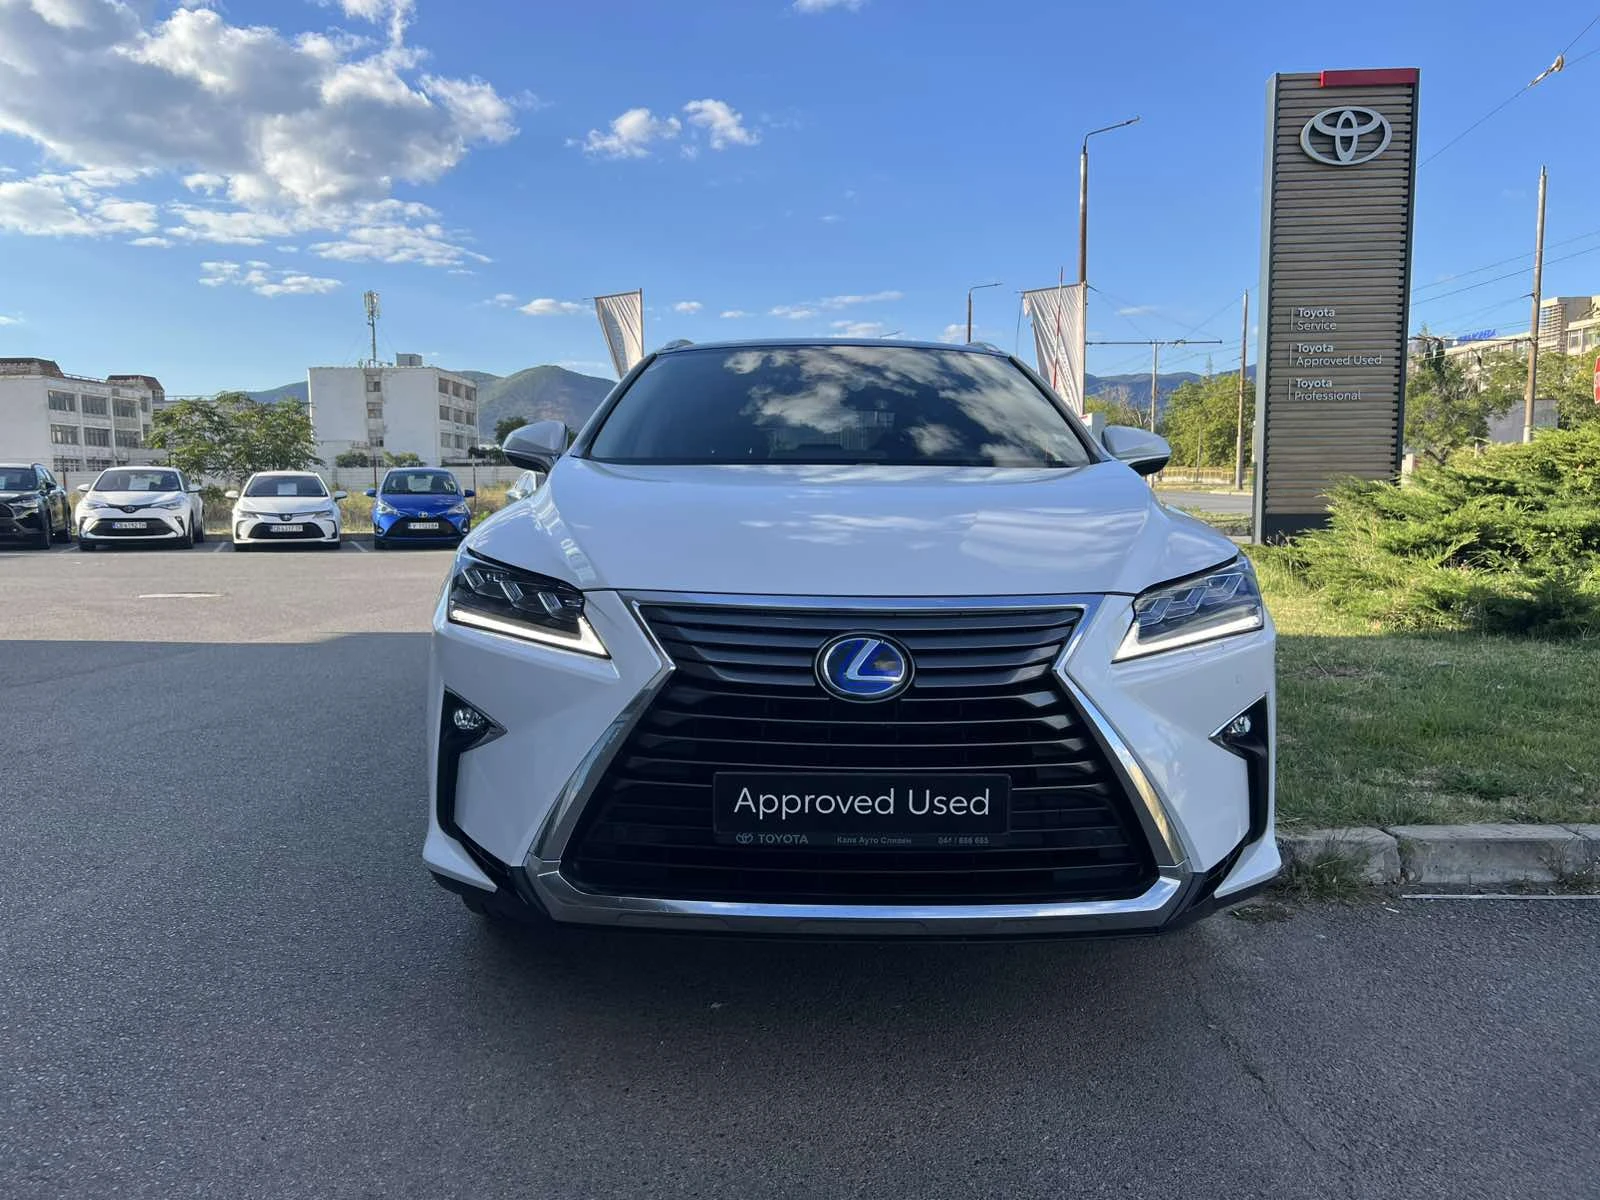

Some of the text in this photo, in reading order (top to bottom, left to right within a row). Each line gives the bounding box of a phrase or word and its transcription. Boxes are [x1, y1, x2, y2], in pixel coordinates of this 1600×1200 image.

[1297, 307, 1336, 319] Toyota
[1297, 320, 1337, 331] Service
[1296, 343, 1335, 354] Toyota
[1296, 354, 1383, 367] Approved Used
[1295, 378, 1333, 389] Toyota
[1294, 389, 1361, 401] Professional
[733, 786, 990, 820] Approved Used
[757, 833, 809, 845] TOYOTA
